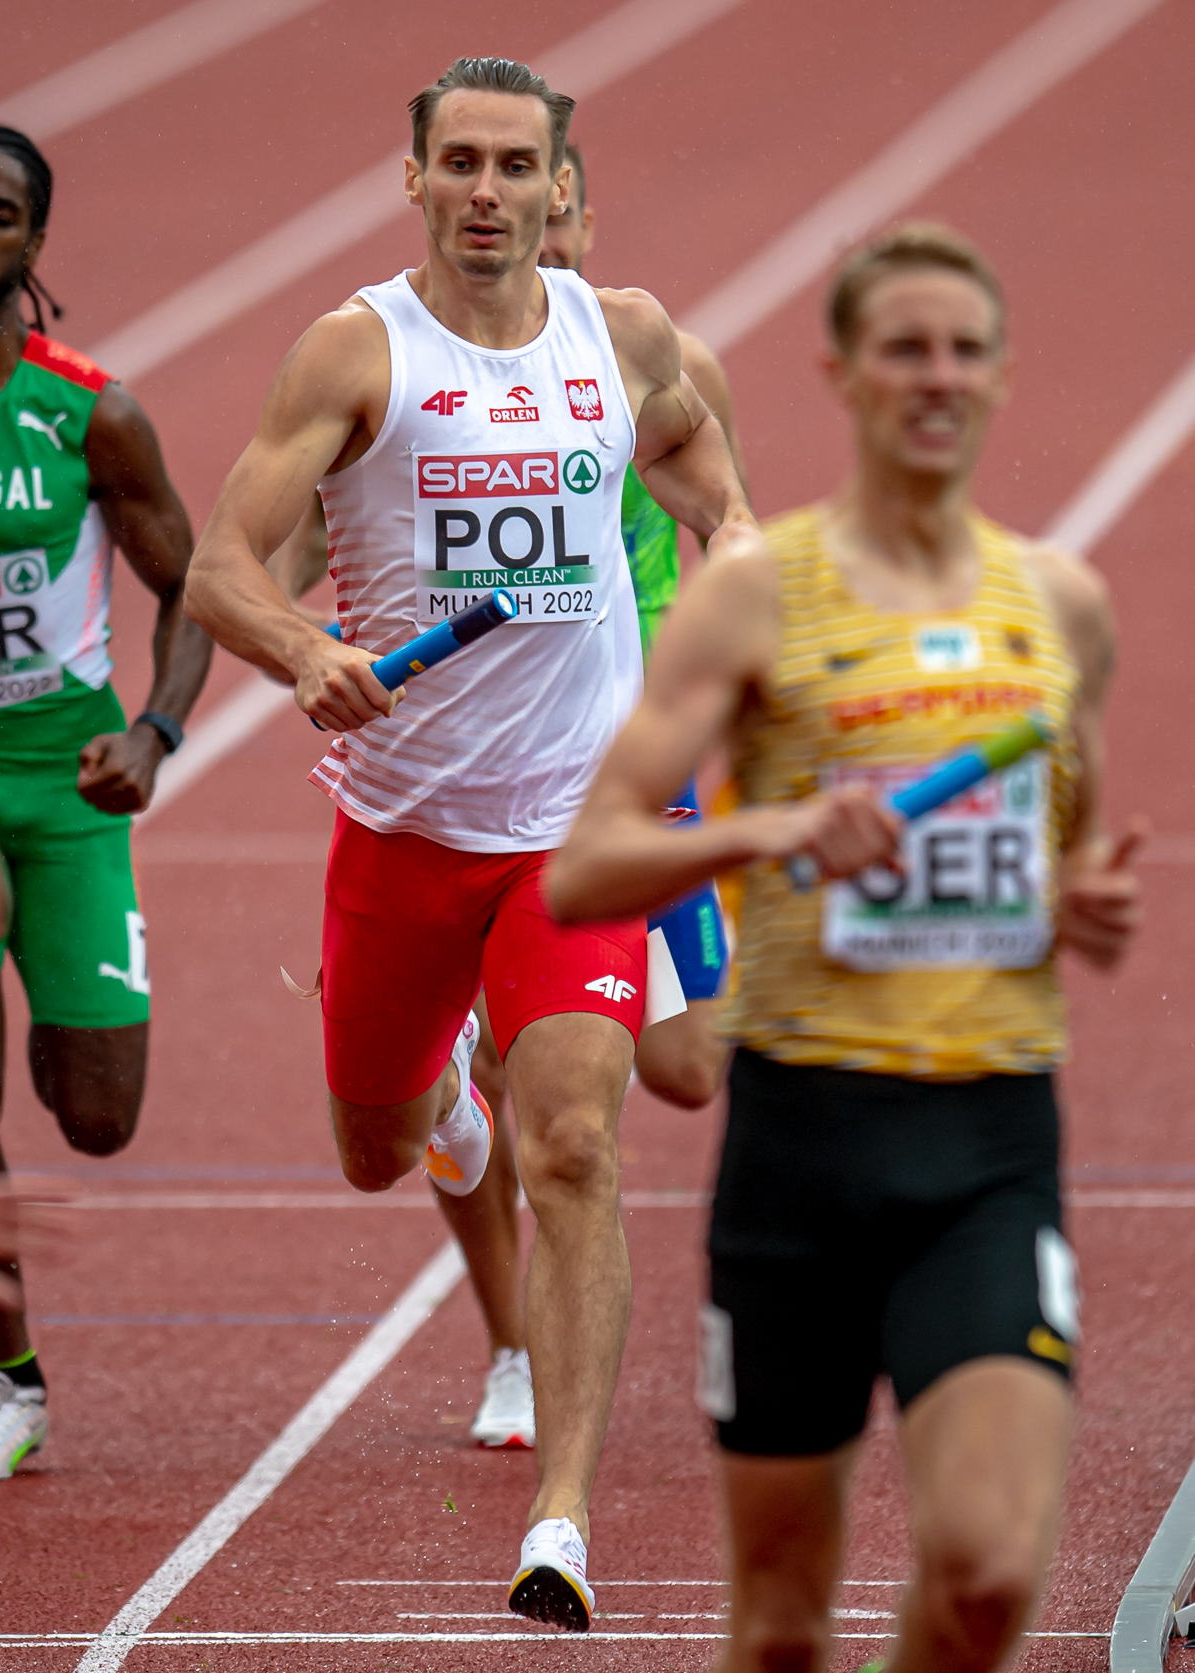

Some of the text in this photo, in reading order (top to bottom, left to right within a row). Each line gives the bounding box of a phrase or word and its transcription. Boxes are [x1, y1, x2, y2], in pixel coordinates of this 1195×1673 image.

[420, 389, 468, 416] 4F
[490, 408, 537, 422] ORLEN
[422, 457, 556, 493] SPAR
[434, 505, 590, 571] POL
[472, 571, 508, 586] RUN
[429, 590, 593, 616] MUH 2022
[584, 974, 637, 1003] 4F
